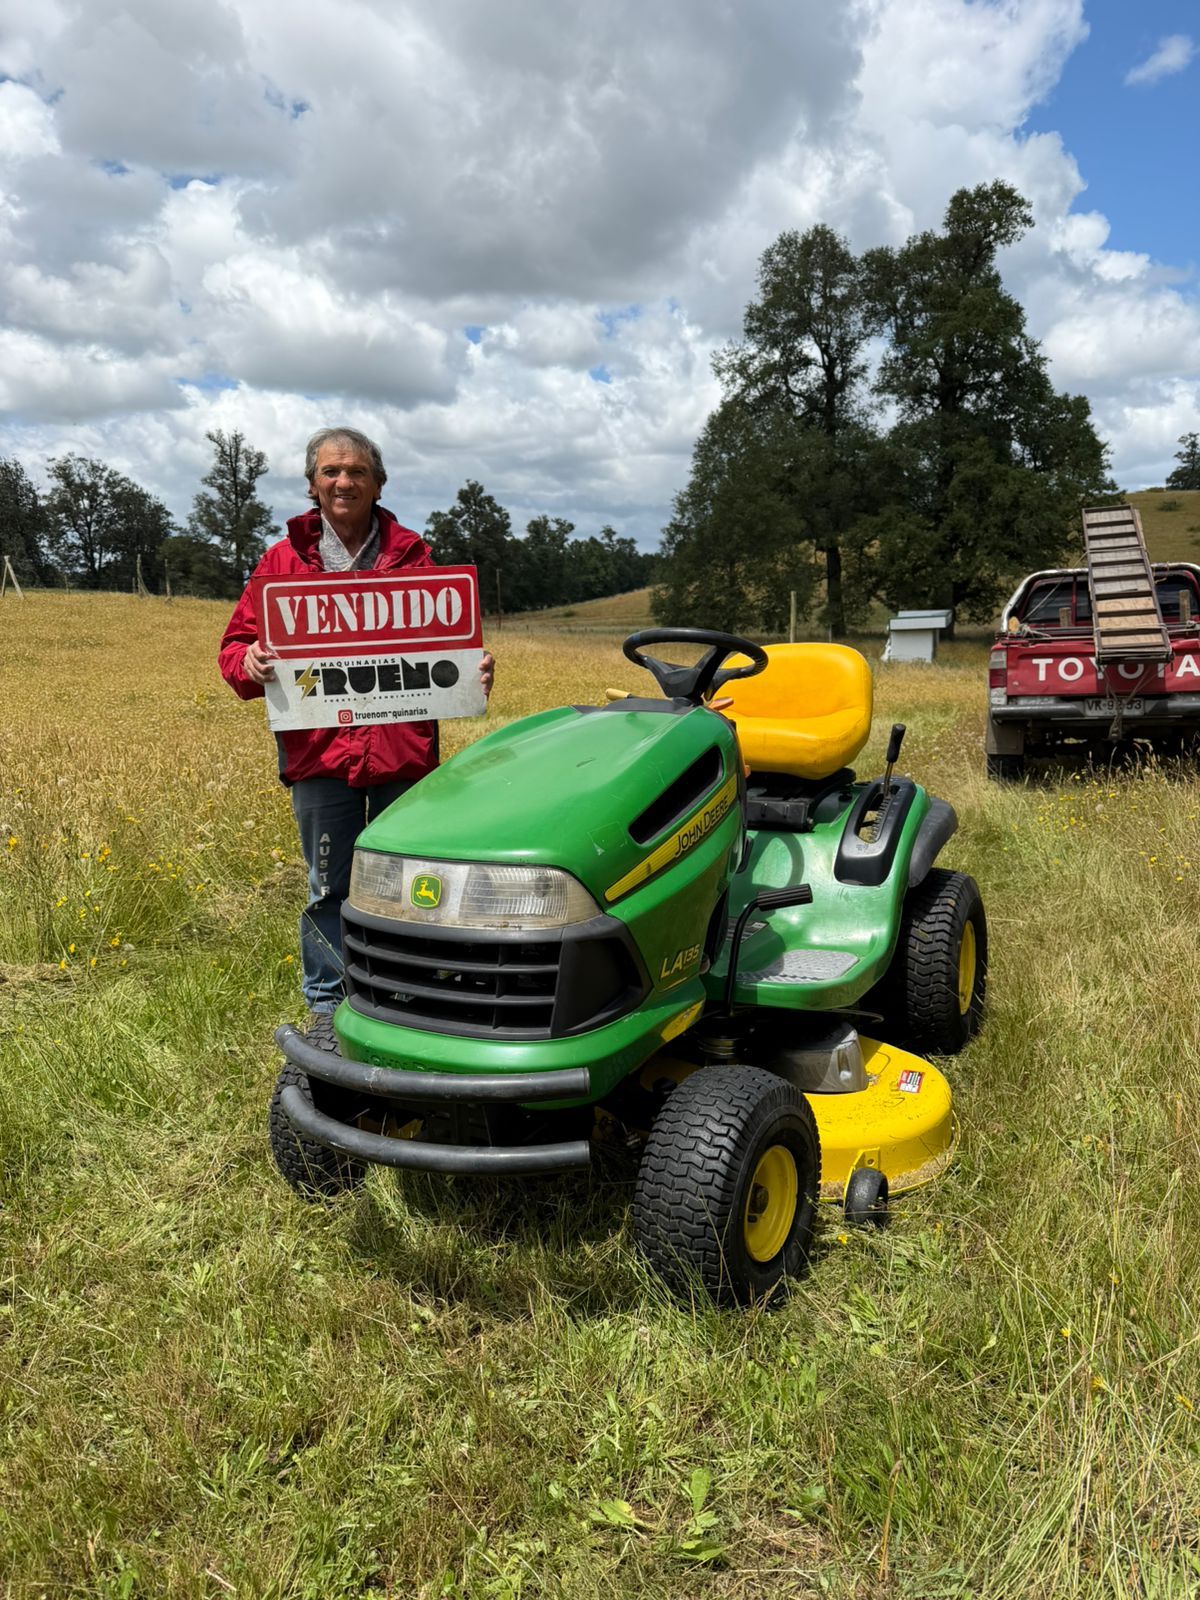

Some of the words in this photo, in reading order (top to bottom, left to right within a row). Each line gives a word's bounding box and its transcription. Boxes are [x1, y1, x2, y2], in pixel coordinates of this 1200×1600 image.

[276, 587, 462, 635] VENDIDO
[294, 656, 459, 698] TRUENO
[320, 658, 396, 668] MAQUINARIAS
[354, 706, 428, 720] truenomquinarias
[675, 819, 704, 857] JOHN
[703, 794, 729, 832] DEERE
